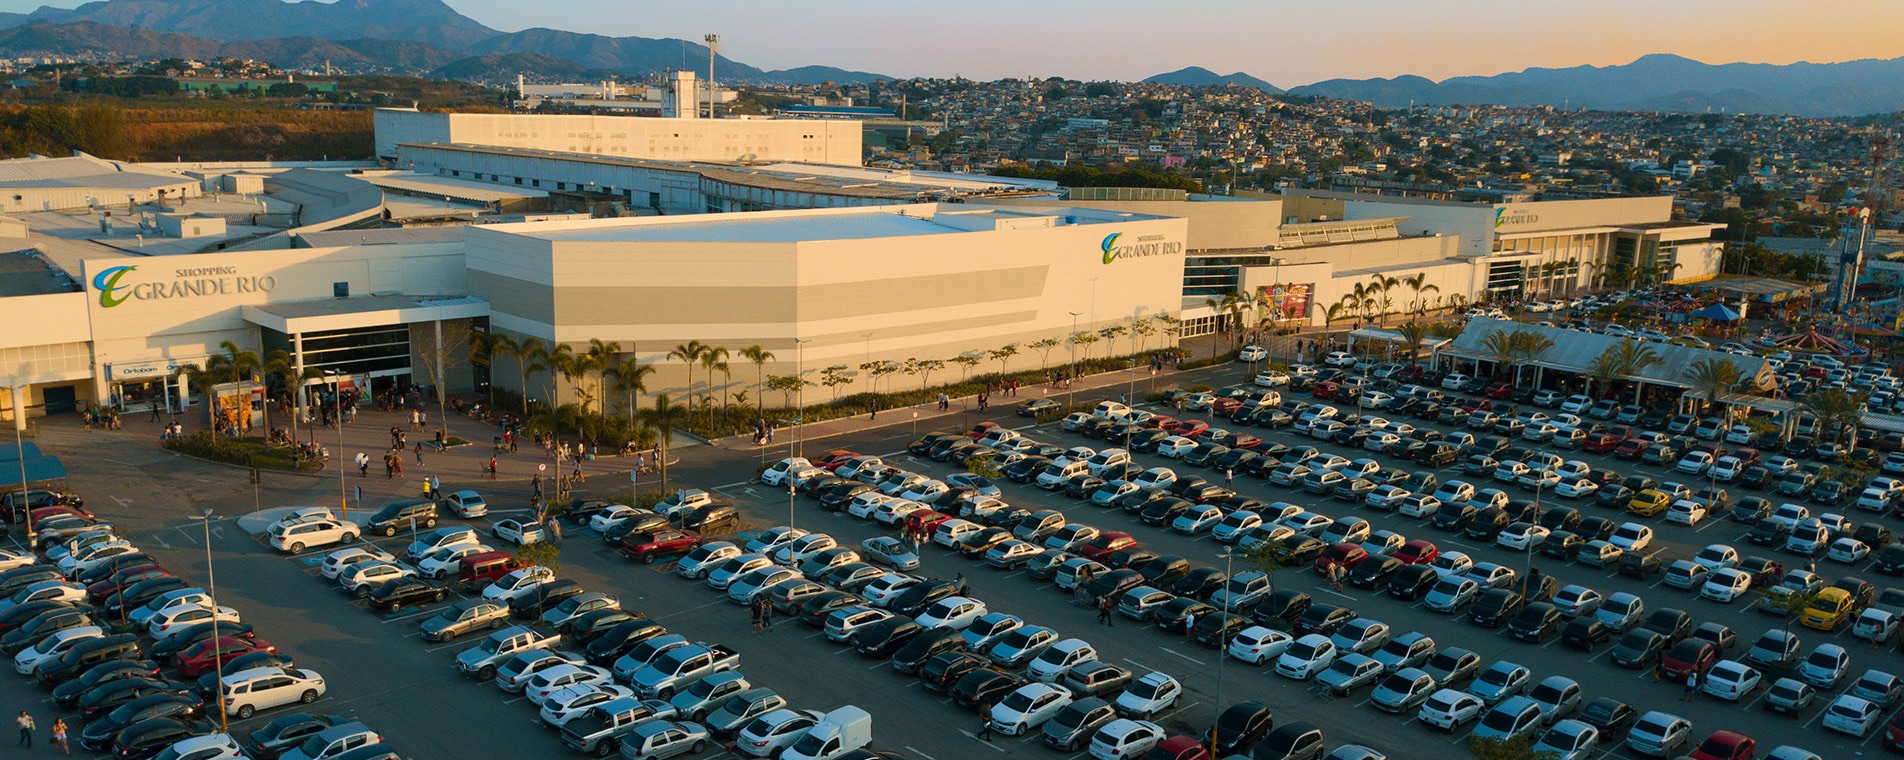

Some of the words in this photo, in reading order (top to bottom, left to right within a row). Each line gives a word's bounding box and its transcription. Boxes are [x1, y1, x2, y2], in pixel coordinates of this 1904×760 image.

[1119, 243, 1160, 259] GRANDE
[1162, 241, 1182, 255] RIO
[176, 267, 237, 277] SHOPPING
[133, 278, 232, 300] GRANDE
[236, 275, 277, 294] RIO
